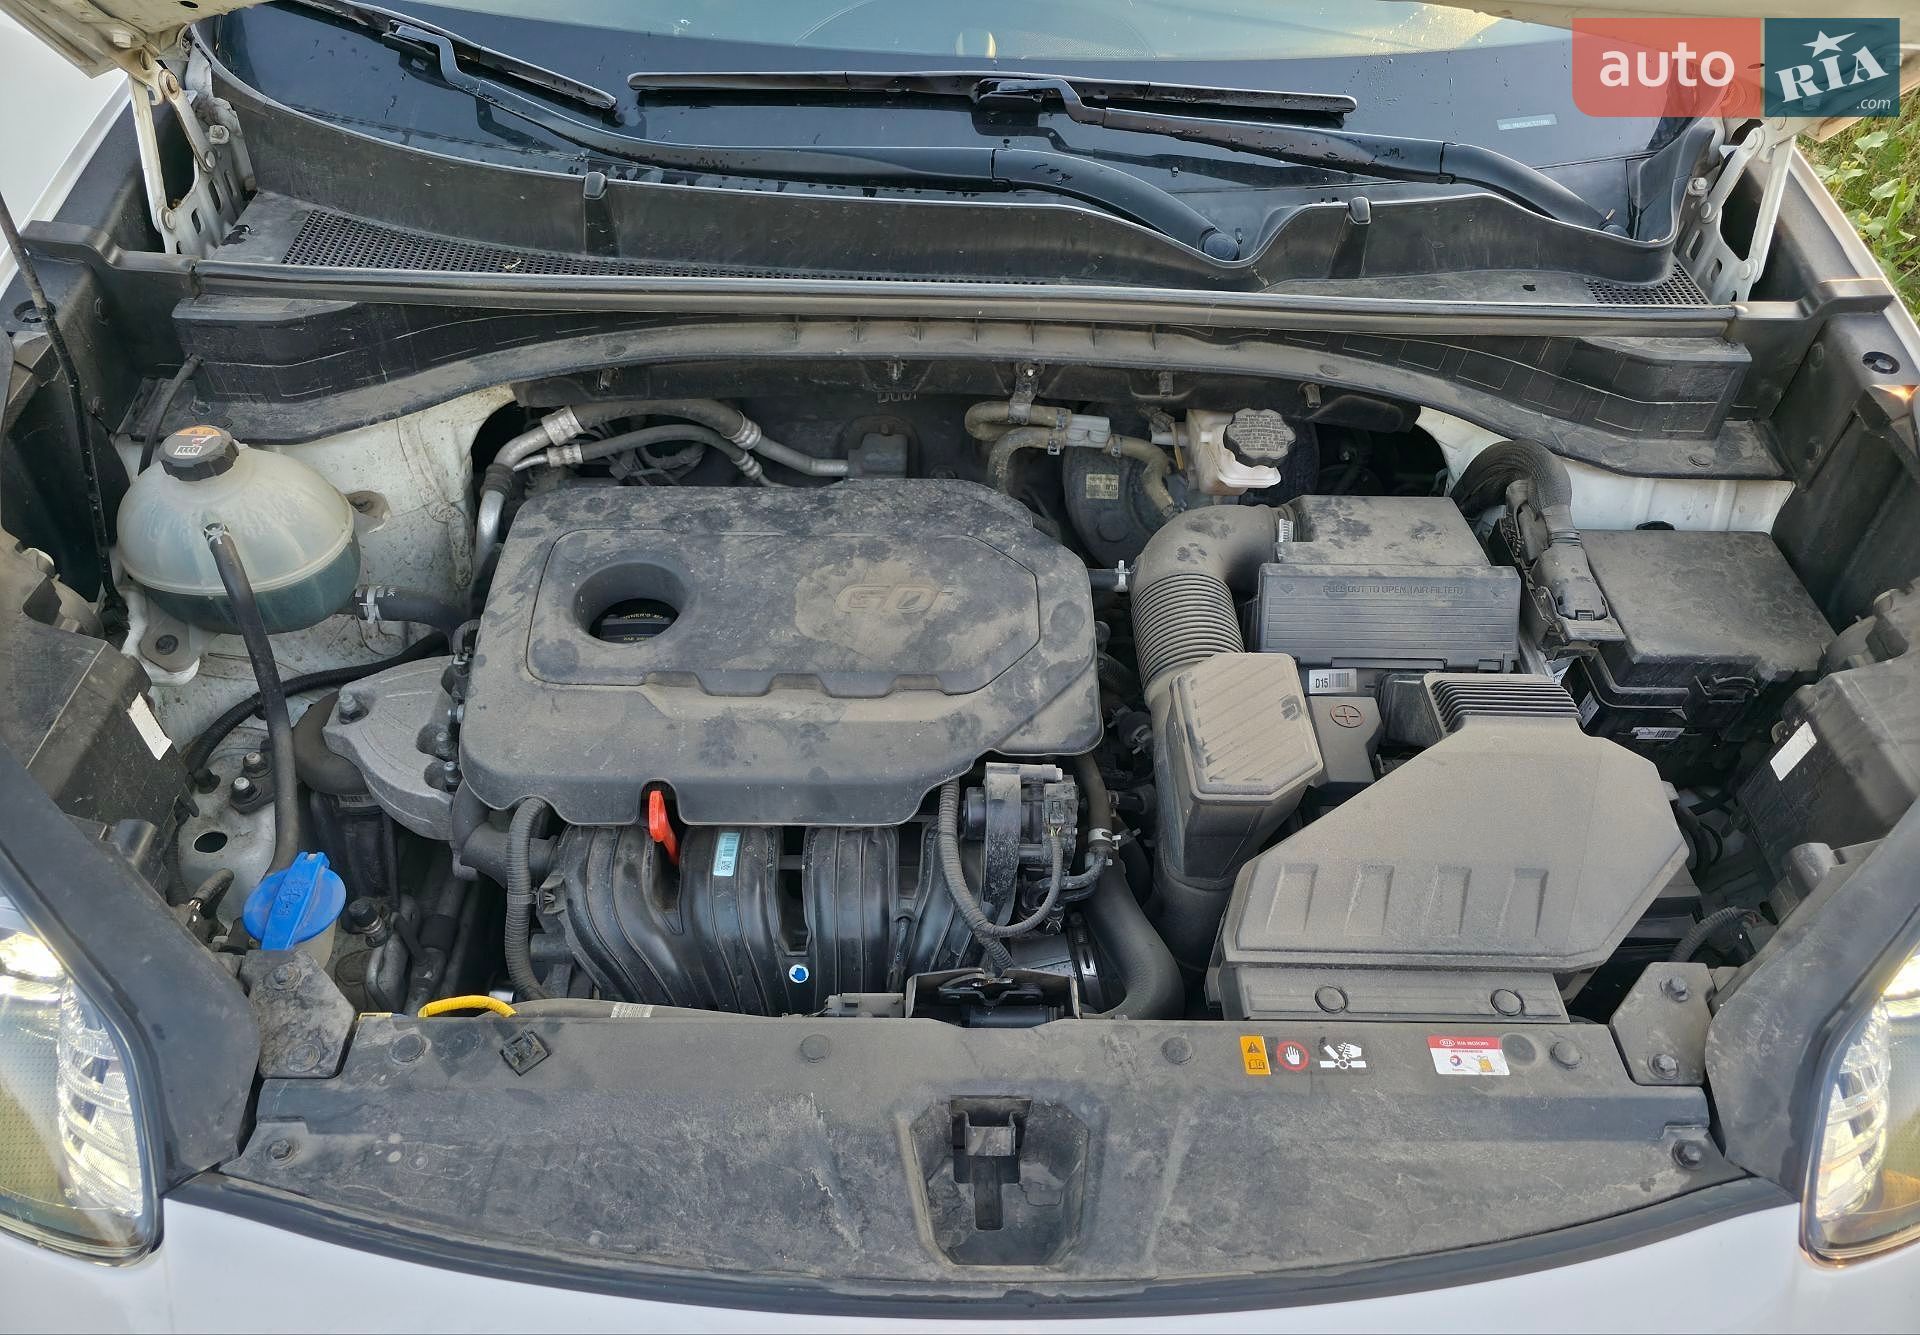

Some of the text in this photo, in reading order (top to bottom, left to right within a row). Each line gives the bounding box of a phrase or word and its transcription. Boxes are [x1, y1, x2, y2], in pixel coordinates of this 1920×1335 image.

[1347, 585, 1366, 593] OUT
[1367, 585, 1380, 593] TO
[1315, 678, 1329, 688] D15
